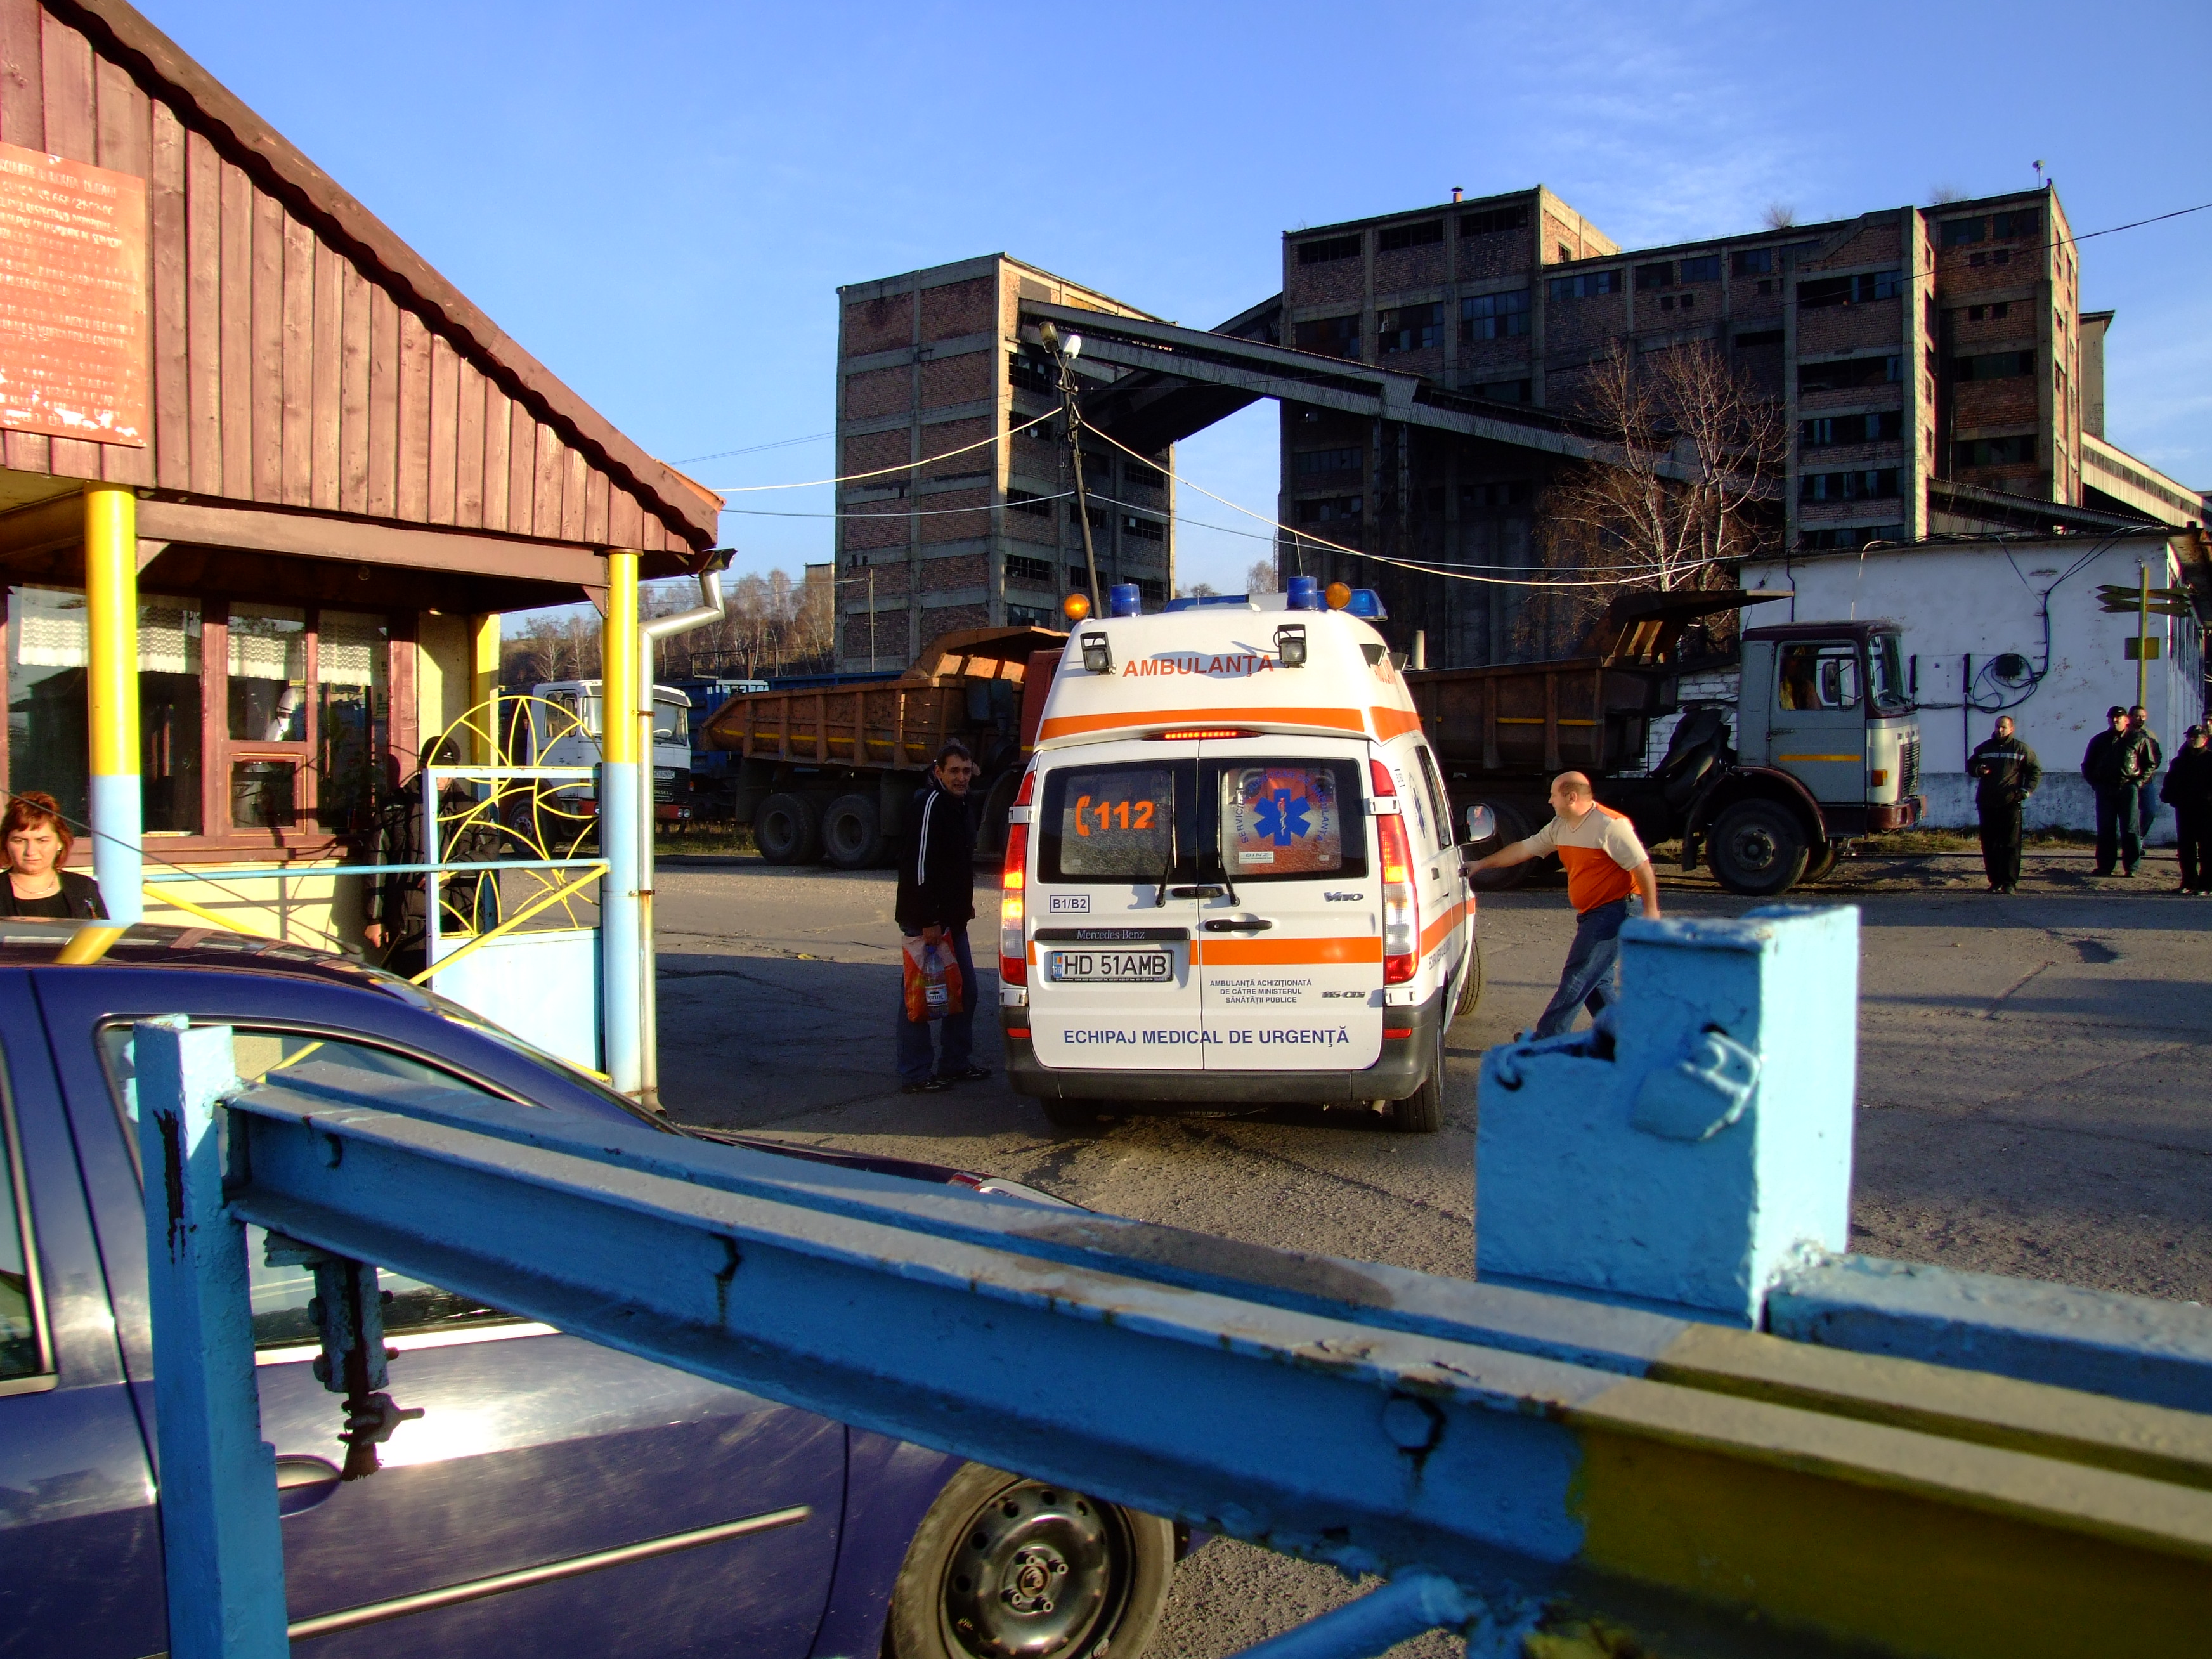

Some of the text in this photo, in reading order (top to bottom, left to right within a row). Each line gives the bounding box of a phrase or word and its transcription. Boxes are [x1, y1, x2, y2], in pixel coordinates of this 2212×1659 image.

[1094, 801, 1155, 829] 112
[1053, 899, 1086, 908] B1/B2
[1077, 929, 1145, 939] Mercedes-Benz
[1064, 955, 1093, 975] HD
[1101, 955, 1166, 975] 51AMB
[1064, 1030, 1136, 1044] ECHIPAJ
[1142, 1030, 1223, 1044] MEDICAL
[1229, 1030, 1253, 1044] DE
